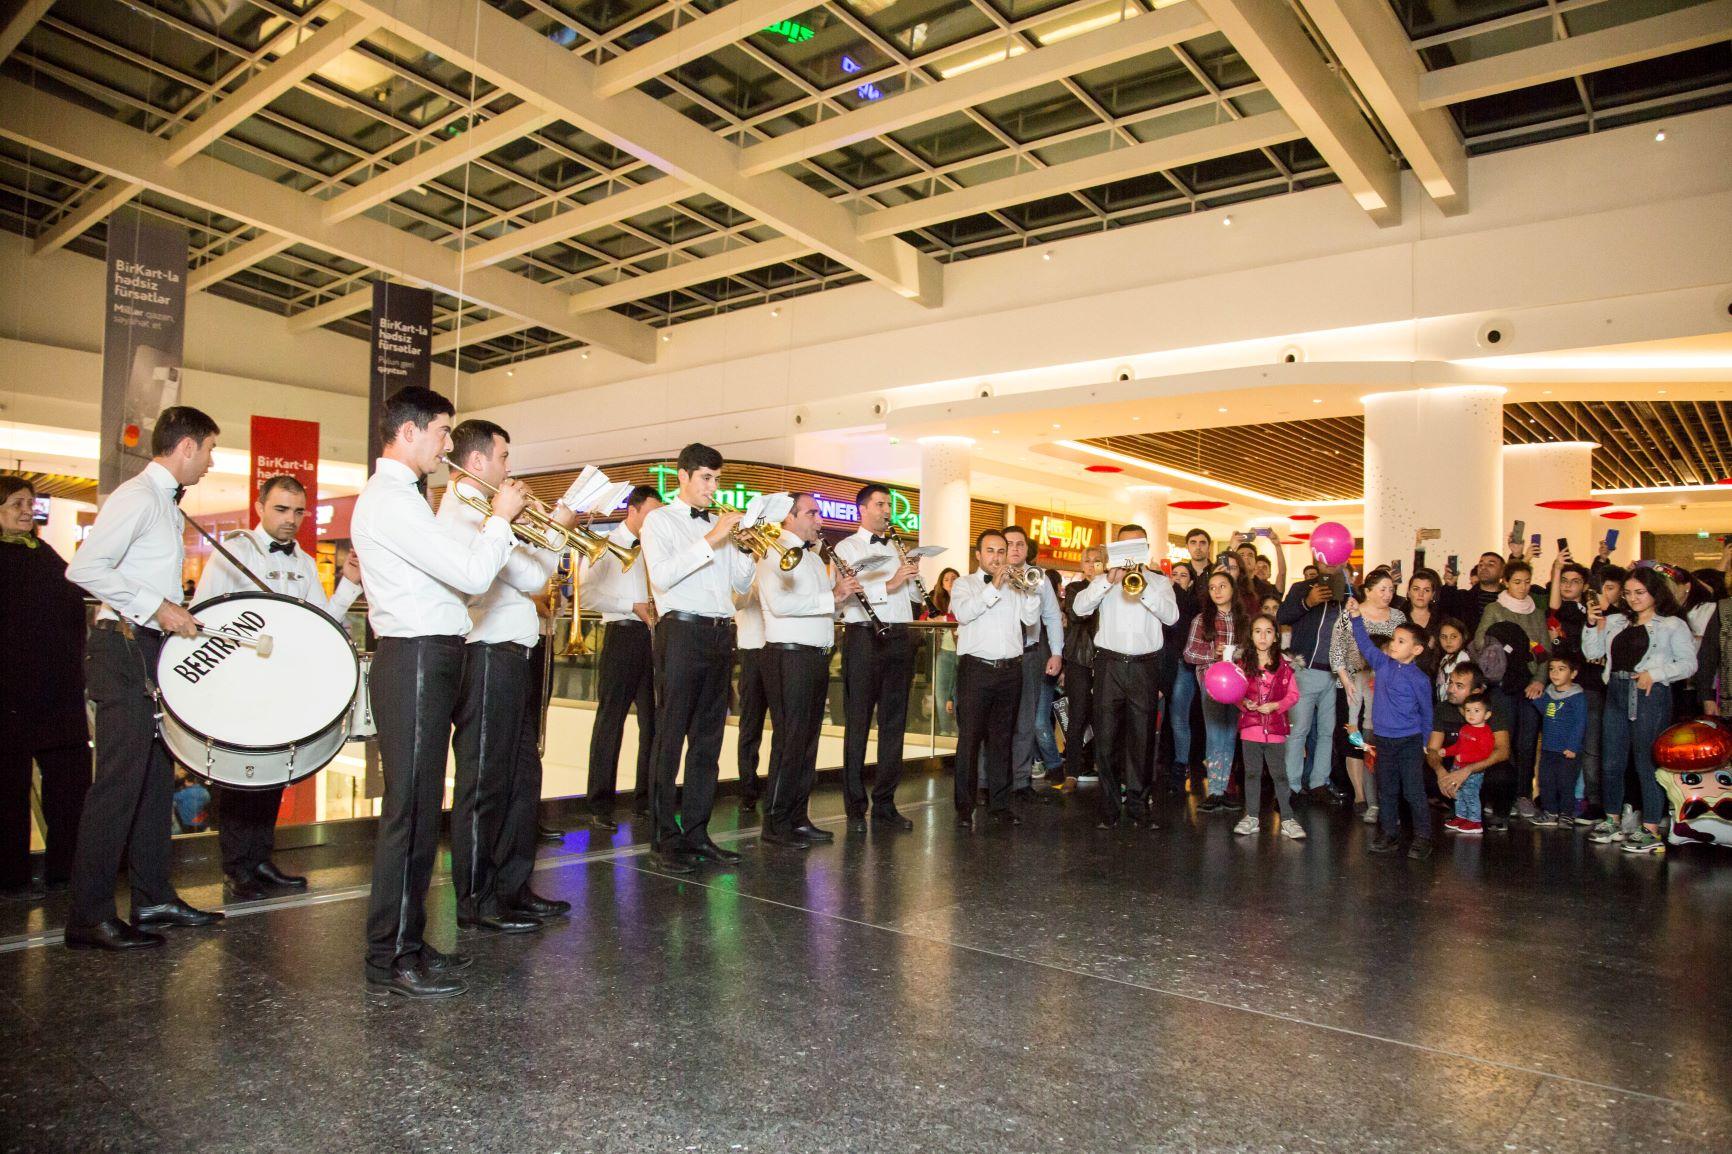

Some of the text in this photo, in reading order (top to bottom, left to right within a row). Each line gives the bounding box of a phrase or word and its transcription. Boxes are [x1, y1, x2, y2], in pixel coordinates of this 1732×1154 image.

[115, 259, 180, 283] BirKart-la
[379, 317, 428, 336] BirKart-la
[257, 455, 315, 471] BirKart-la
[172, 610, 266, 684] BERTRAND
